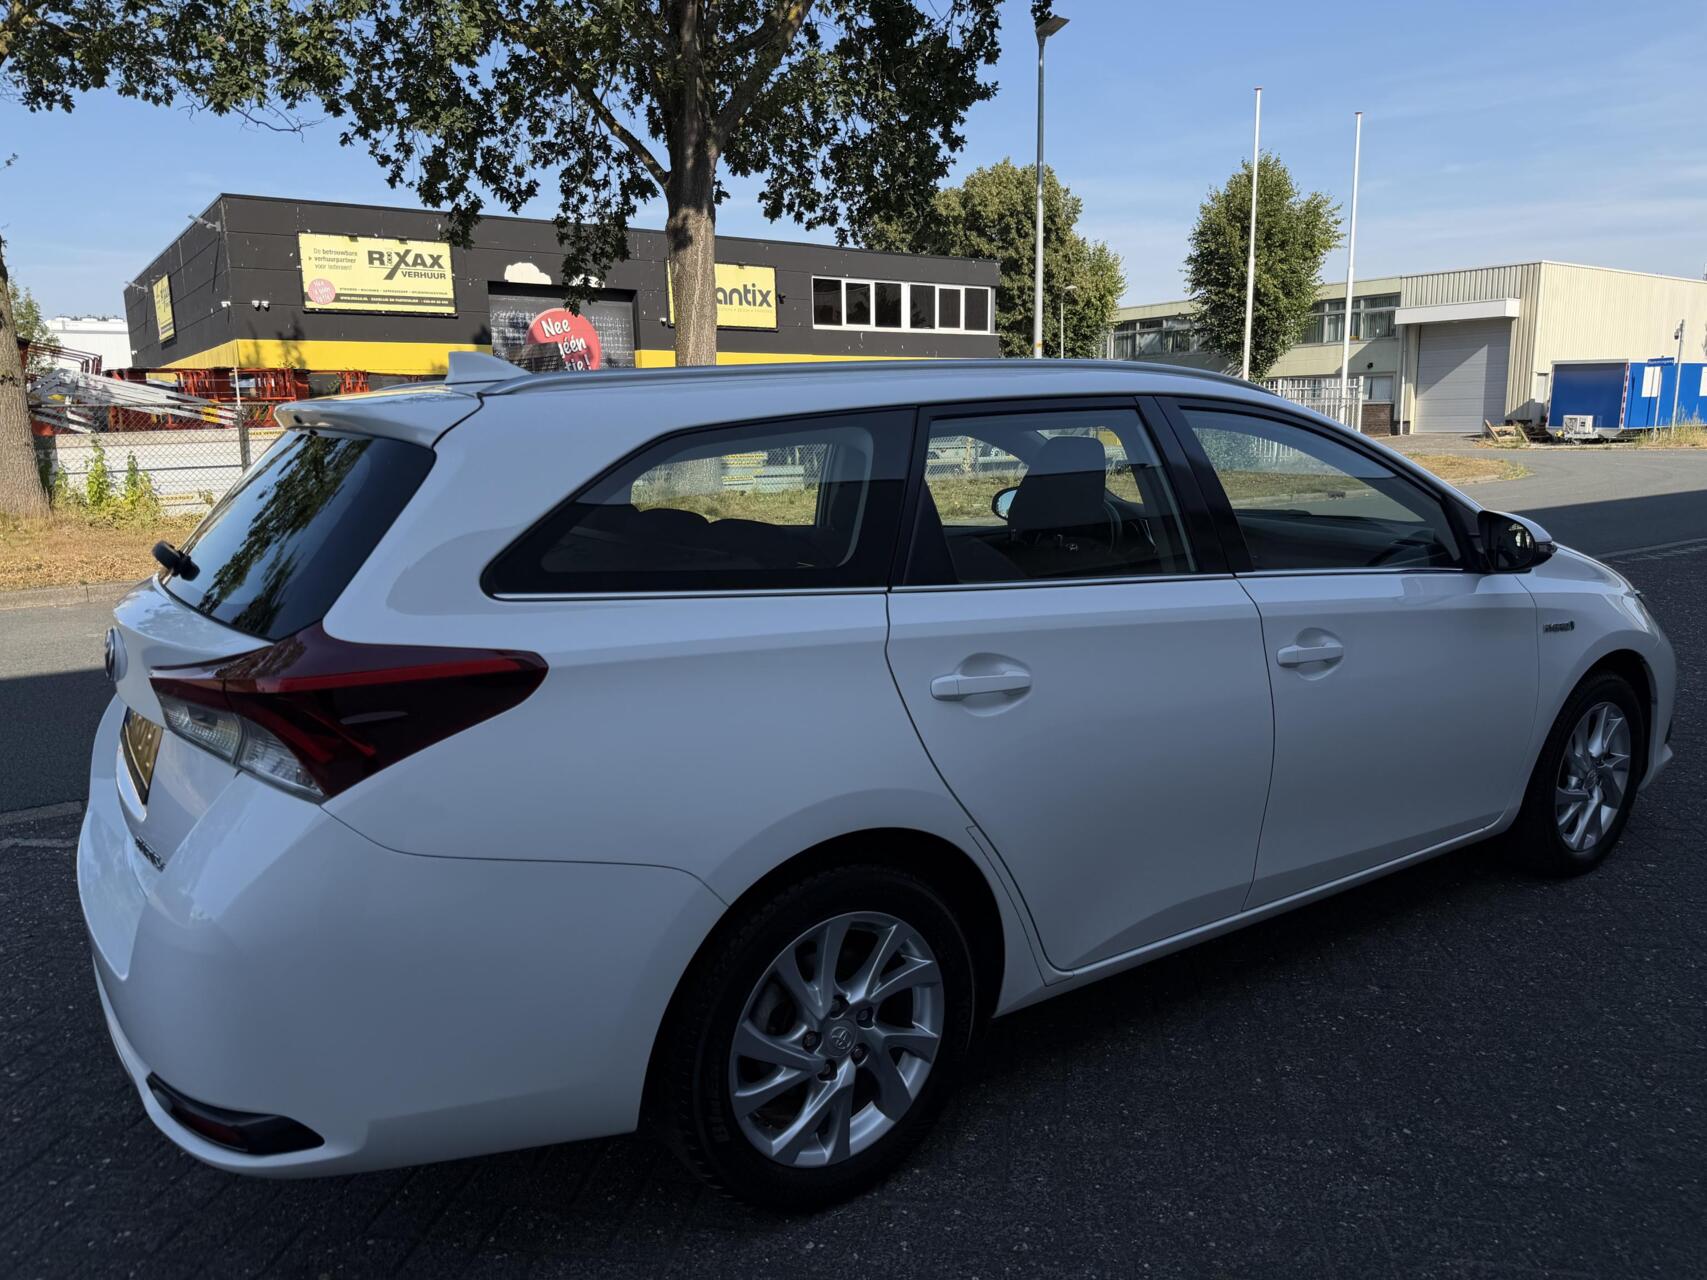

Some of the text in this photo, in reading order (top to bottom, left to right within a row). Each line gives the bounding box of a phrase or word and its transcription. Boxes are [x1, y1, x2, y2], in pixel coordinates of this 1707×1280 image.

[314, 256, 357, 264] verhuurpartner
[401, 271, 447, 280] VERHUUR
[716, 283, 773, 308] antix
[540, 317, 571, 338] Nee
[565, 354, 592, 371] tie!
